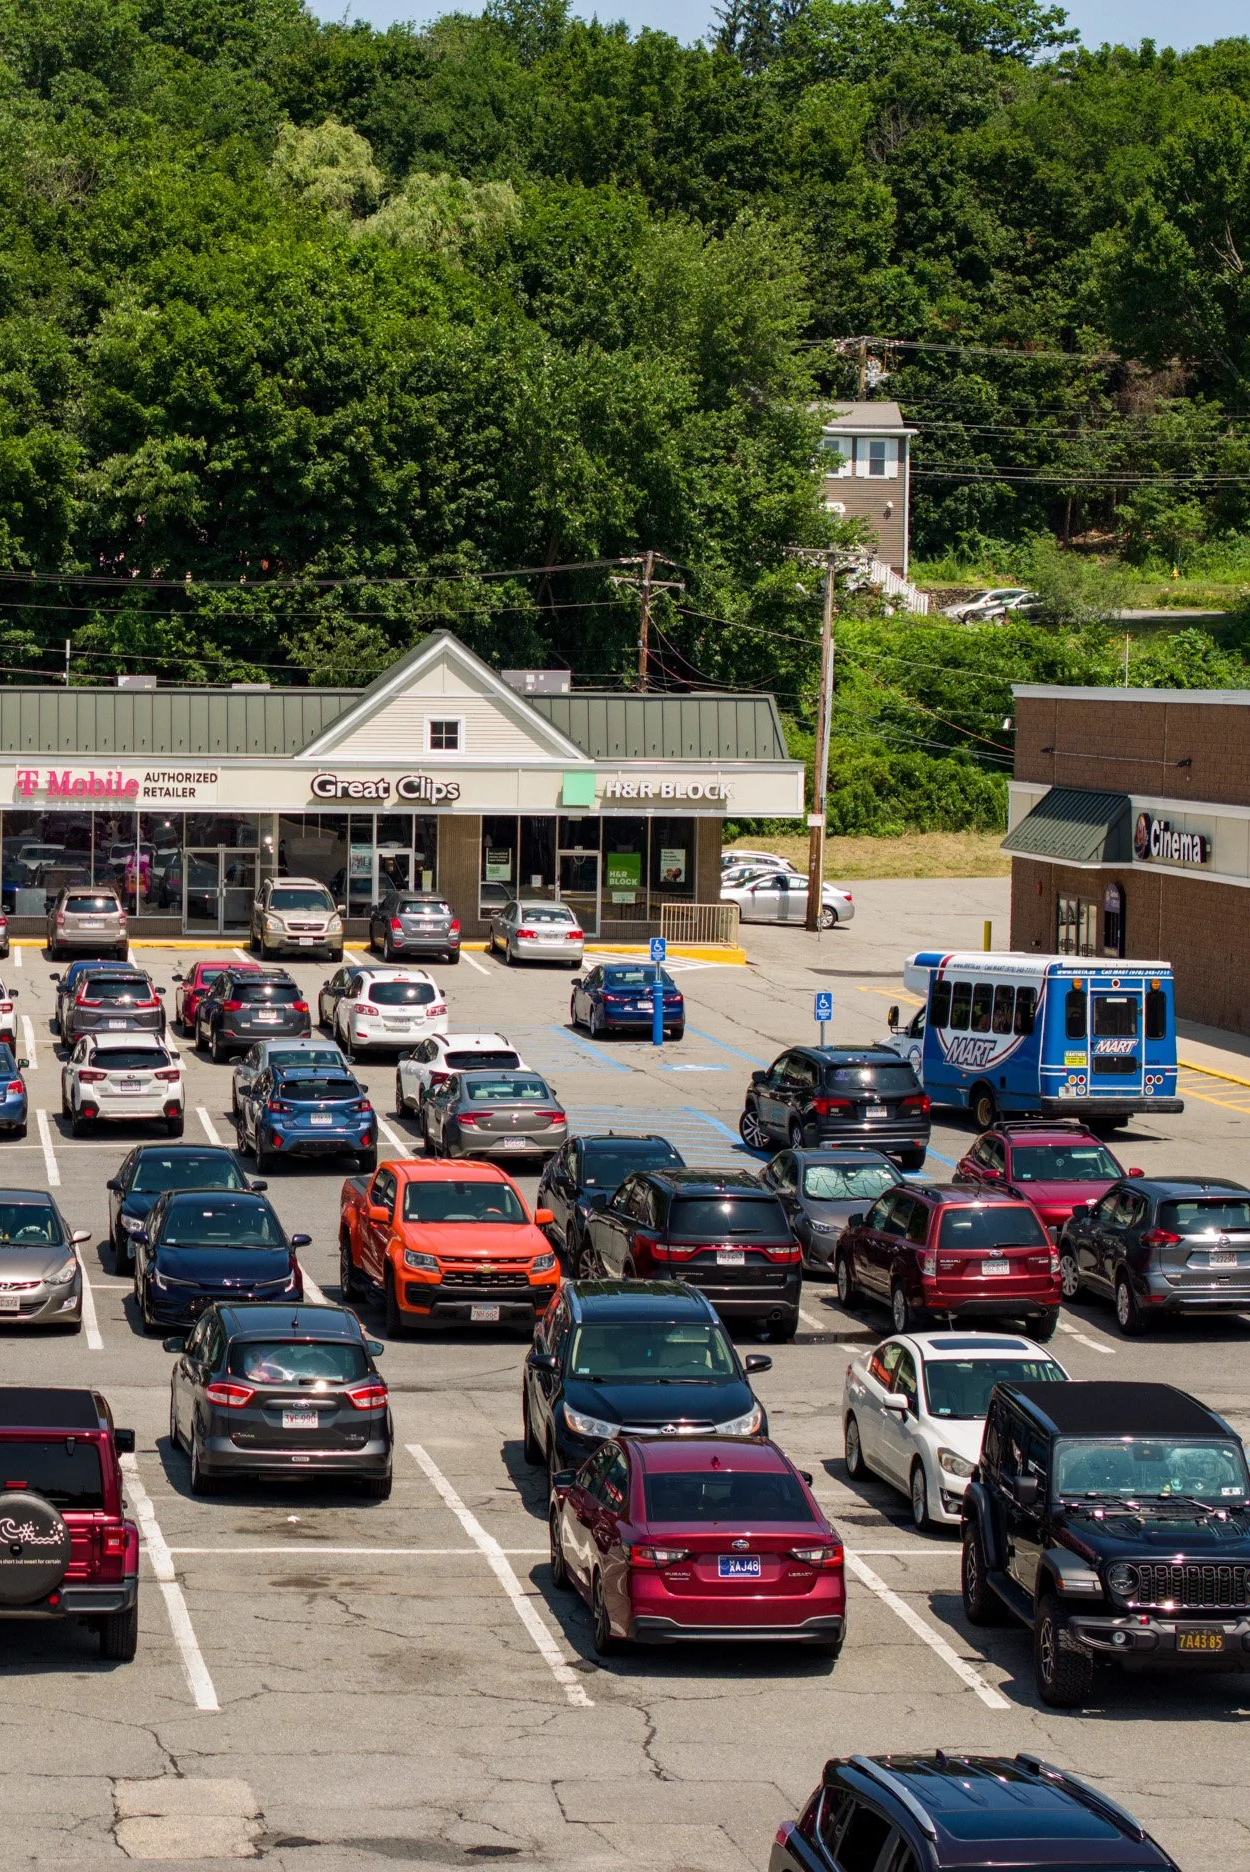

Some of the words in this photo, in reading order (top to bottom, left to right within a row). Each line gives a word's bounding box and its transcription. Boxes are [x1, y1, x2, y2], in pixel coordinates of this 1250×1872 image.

[46, 770, 140, 797] Mobile
[144, 772, 218, 784] AUTHORIZED
[143, 786, 196, 798] RETAILER
[311, 773, 390, 799] Great
[396, 775, 461, 806] Clips
[606, 781, 654, 798] H&R
[660, 782, 735, 799] BLOCK
[1150, 819, 1204, 864] Cinema
[944, 1036, 997, 1067] MART
[1092, 1039, 1139, 1054] MART
